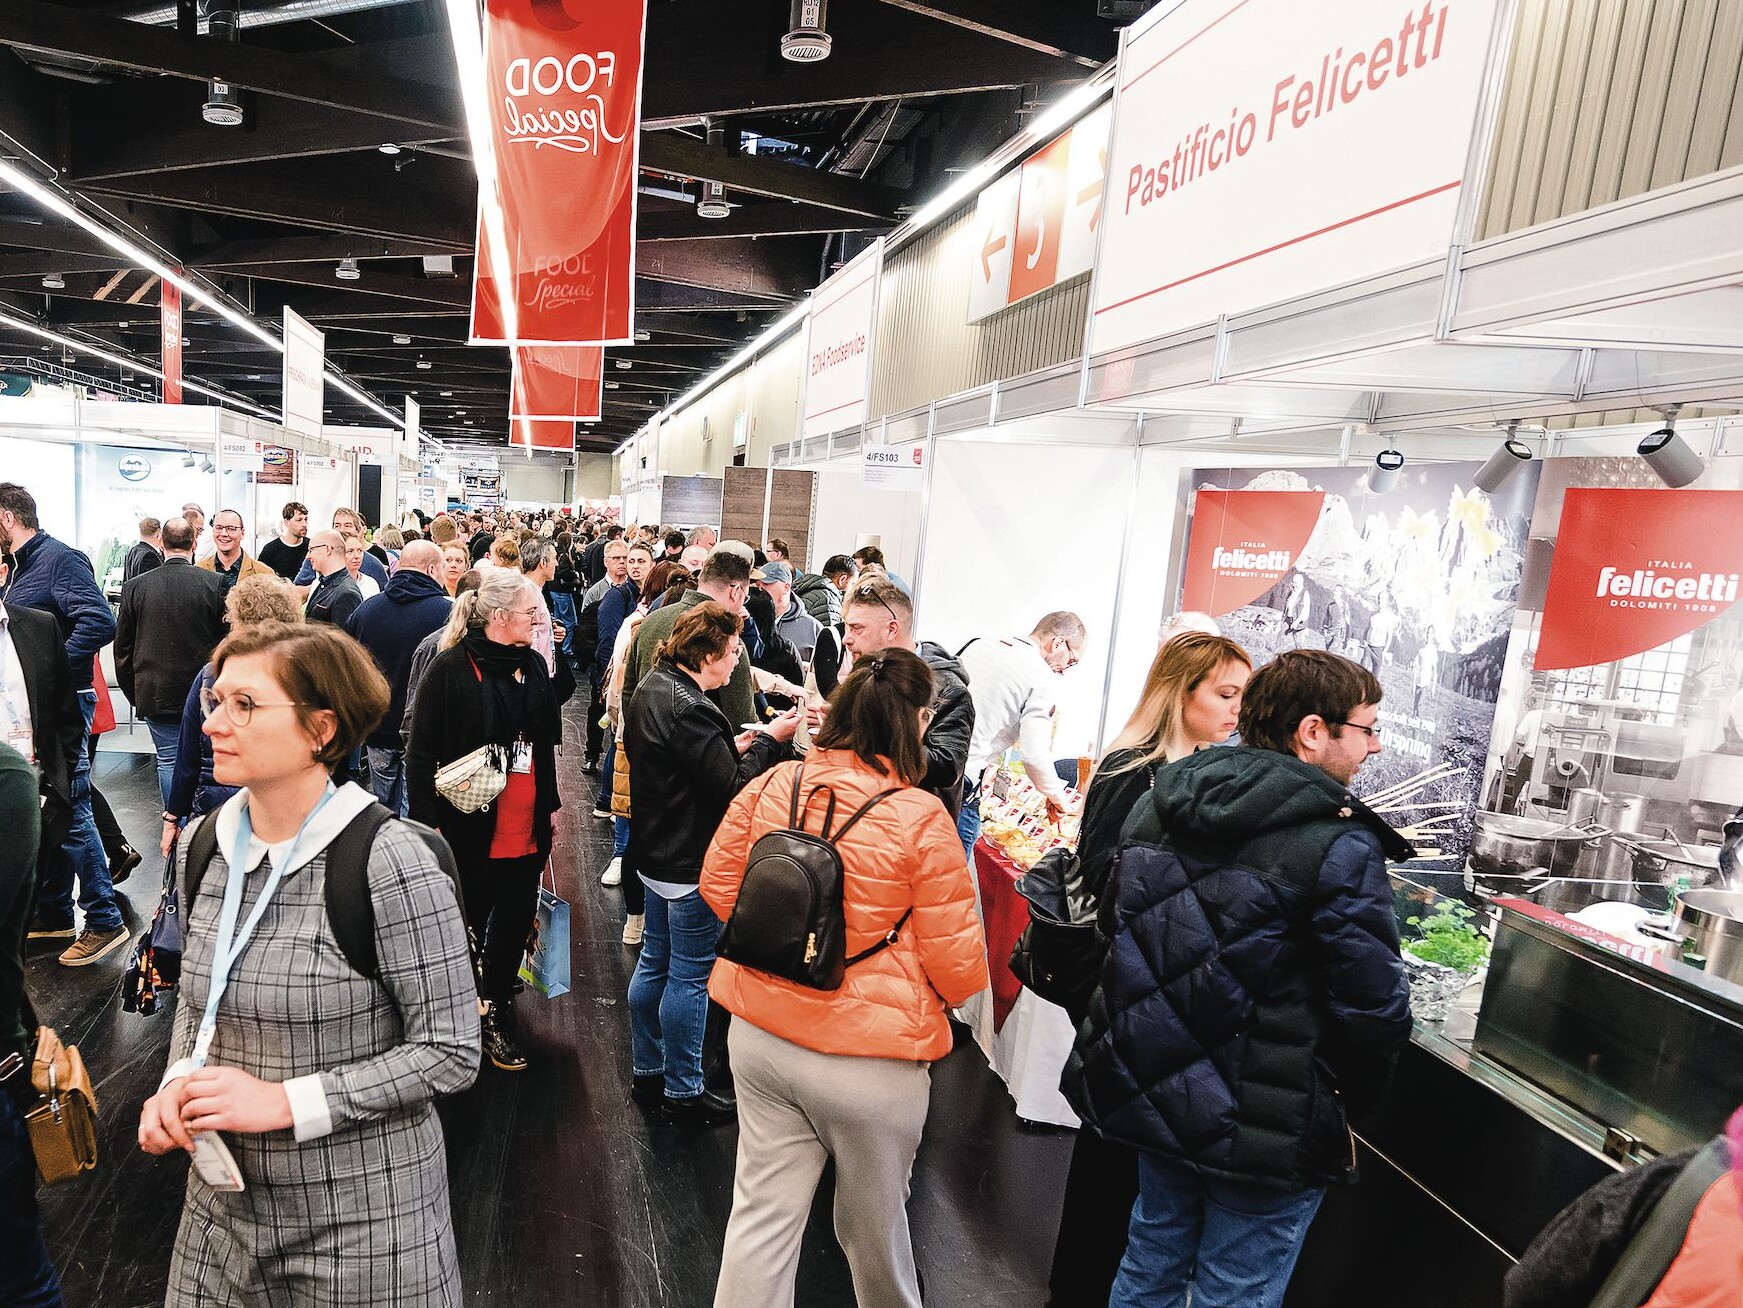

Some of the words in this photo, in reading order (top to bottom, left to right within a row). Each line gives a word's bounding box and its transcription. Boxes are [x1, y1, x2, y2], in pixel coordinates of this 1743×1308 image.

[806, 8, 815, 16] 01
[805, 17, 815, 26] 05
[1125, 107, 1256, 215] Pastificio
[1267, 0, 1449, 142] Felicetti
[826, 331, 865, 369] Foodservice
[866, 452, 899, 462] 4/FS103
[1212, 546, 1291, 571] felicetti
[1648, 560, 1693, 569] ITALIA
[1220, 570, 1257, 578] DOLOMITI
[1596, 566, 1739, 602] felicetti
[1610, 600, 1677, 611] DOLOMITI
[1685, 603, 1717, 613] 1908
